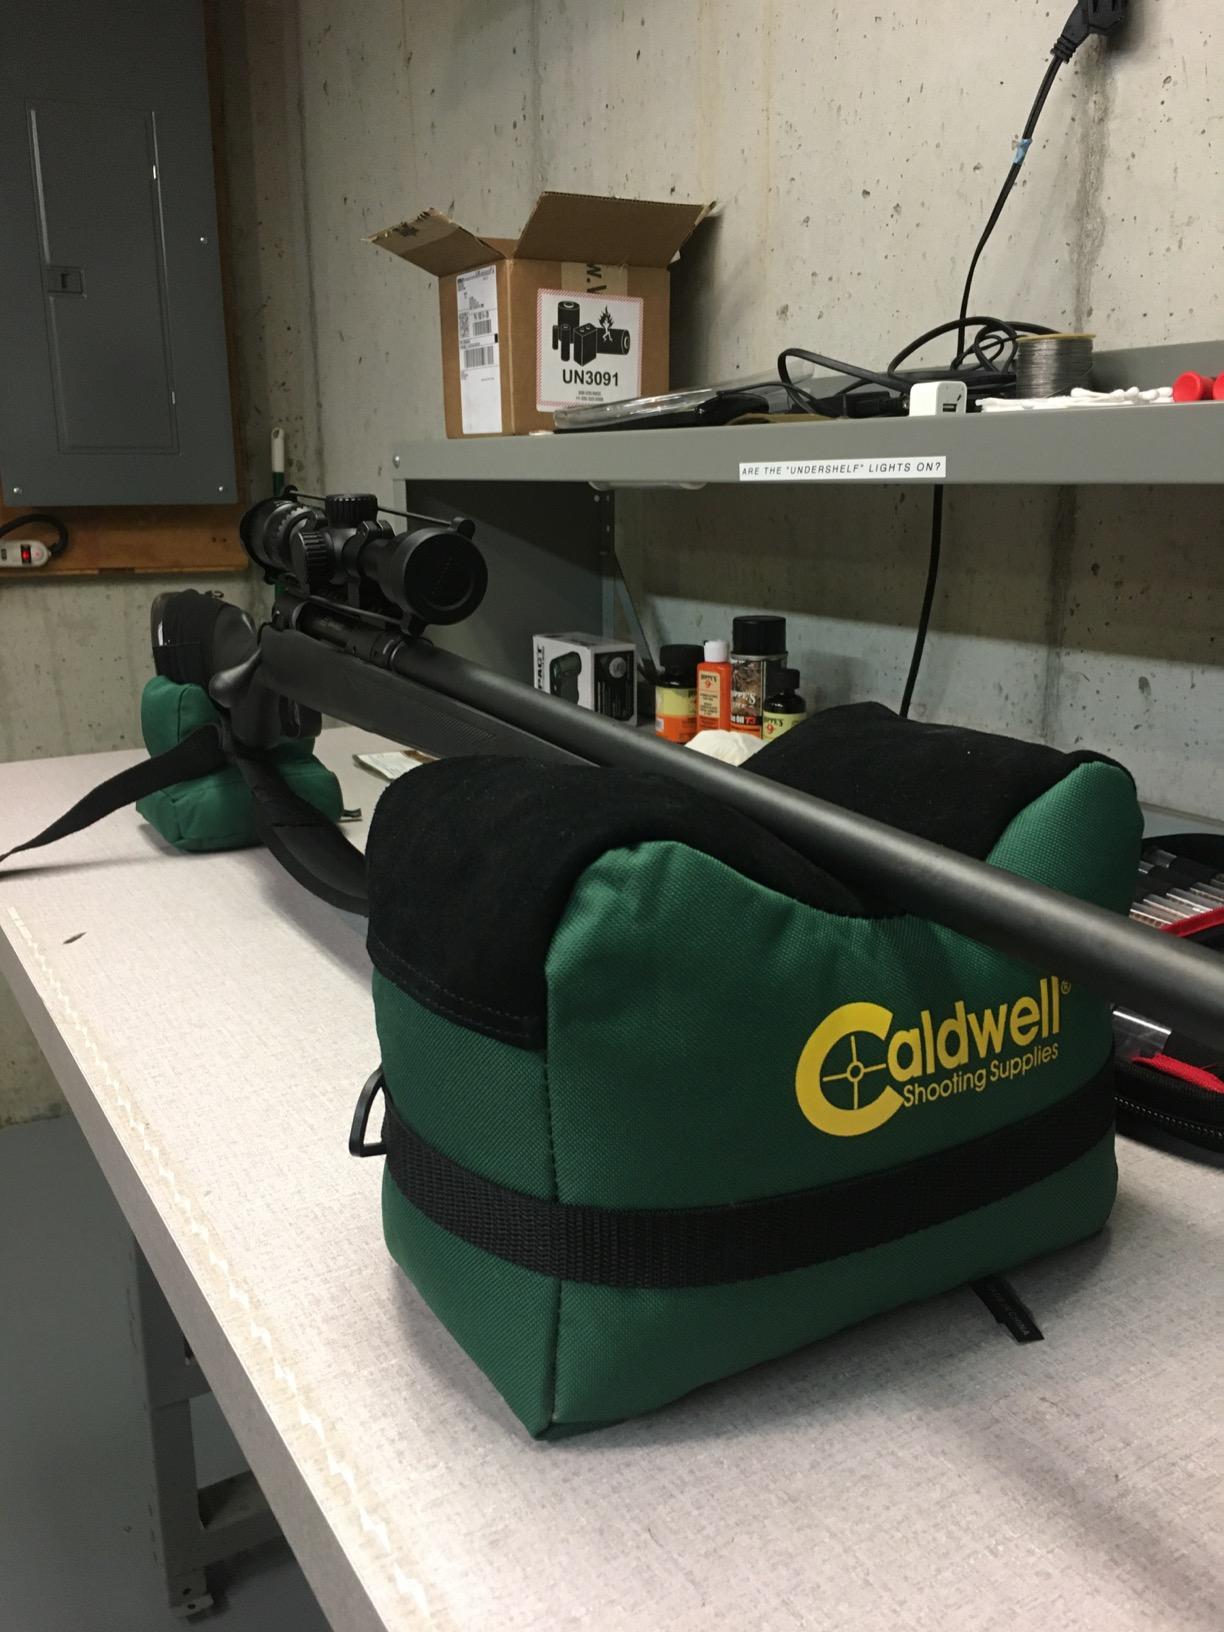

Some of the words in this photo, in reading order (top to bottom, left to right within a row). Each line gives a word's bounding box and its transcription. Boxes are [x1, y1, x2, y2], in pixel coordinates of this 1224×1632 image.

[562, 369, 618, 387] UN3091
[742, 466, 760, 475] ARE
[764, 466, 782, 475] THE
[868, 462, 910, 472] LIGHTS
[916, 461, 941, 472] ON?
[795, 976, 1060, 1136] Caldwell
[903, 1069, 987, 1107] Shooting
[989, 1042, 1059, 1083] Supplies
